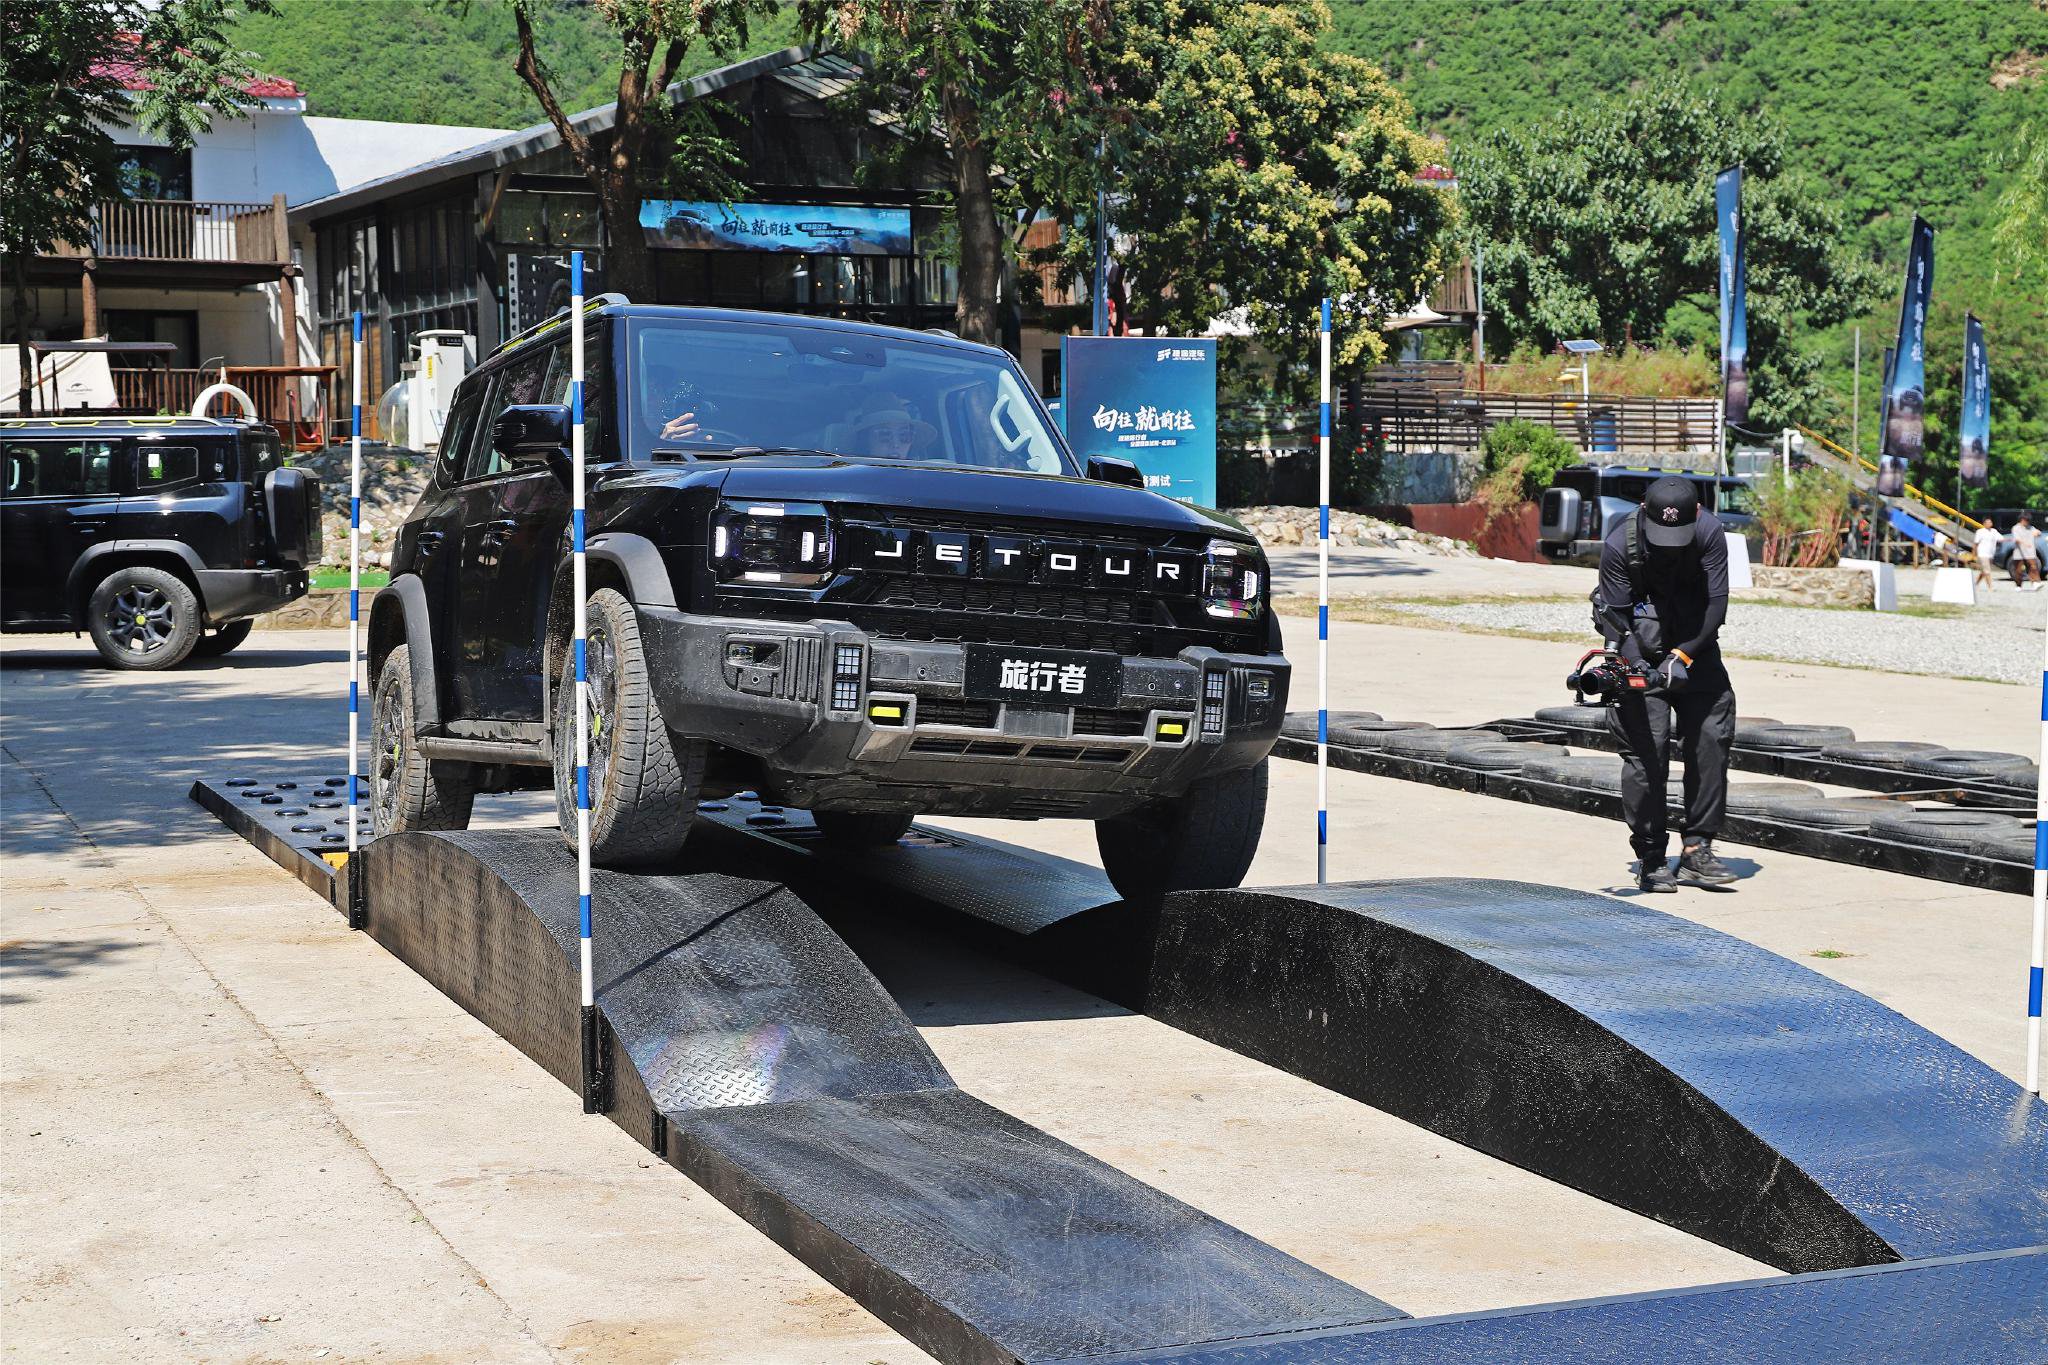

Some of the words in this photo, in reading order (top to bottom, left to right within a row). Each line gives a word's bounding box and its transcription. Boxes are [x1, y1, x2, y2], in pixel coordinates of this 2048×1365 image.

[1092, 404, 1196, 432] 向往就前往
[874, 541, 1180, 580] JETOUR
[999, 658, 1088, 694] 旅行者
